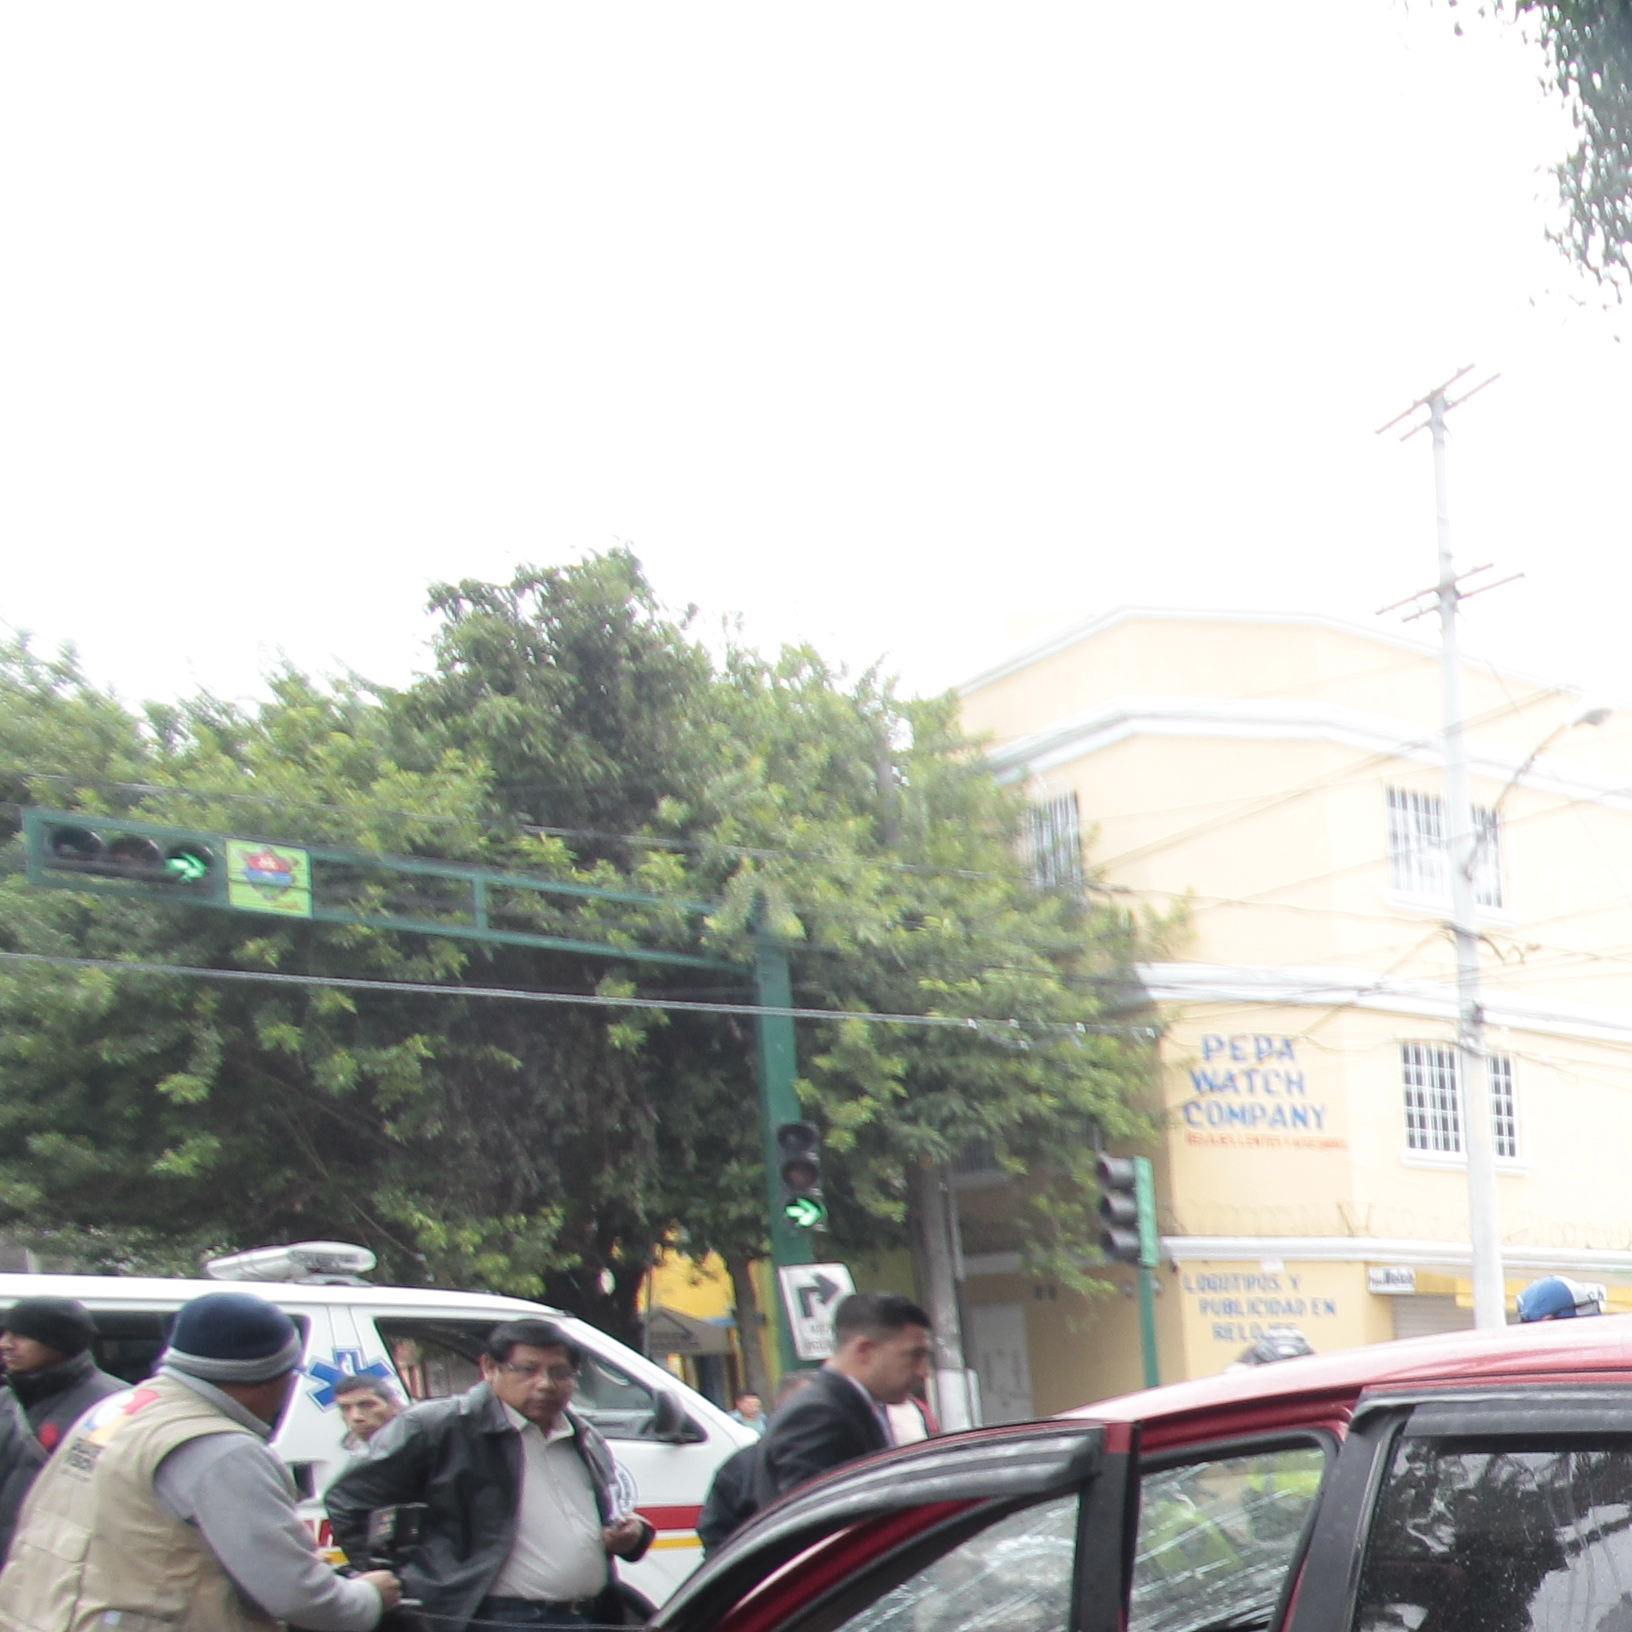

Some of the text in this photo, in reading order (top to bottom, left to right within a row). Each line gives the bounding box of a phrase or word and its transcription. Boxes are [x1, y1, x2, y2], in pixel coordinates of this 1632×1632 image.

[1189, 1068, 1307, 1096] WATCH
[1182, 1100, 1327, 1129] COMPANY
[1183, 1272, 1300, 1293] LOGOTIPOS Y
[1199, 1297, 1337, 1316] PUBLICIDAD EN
